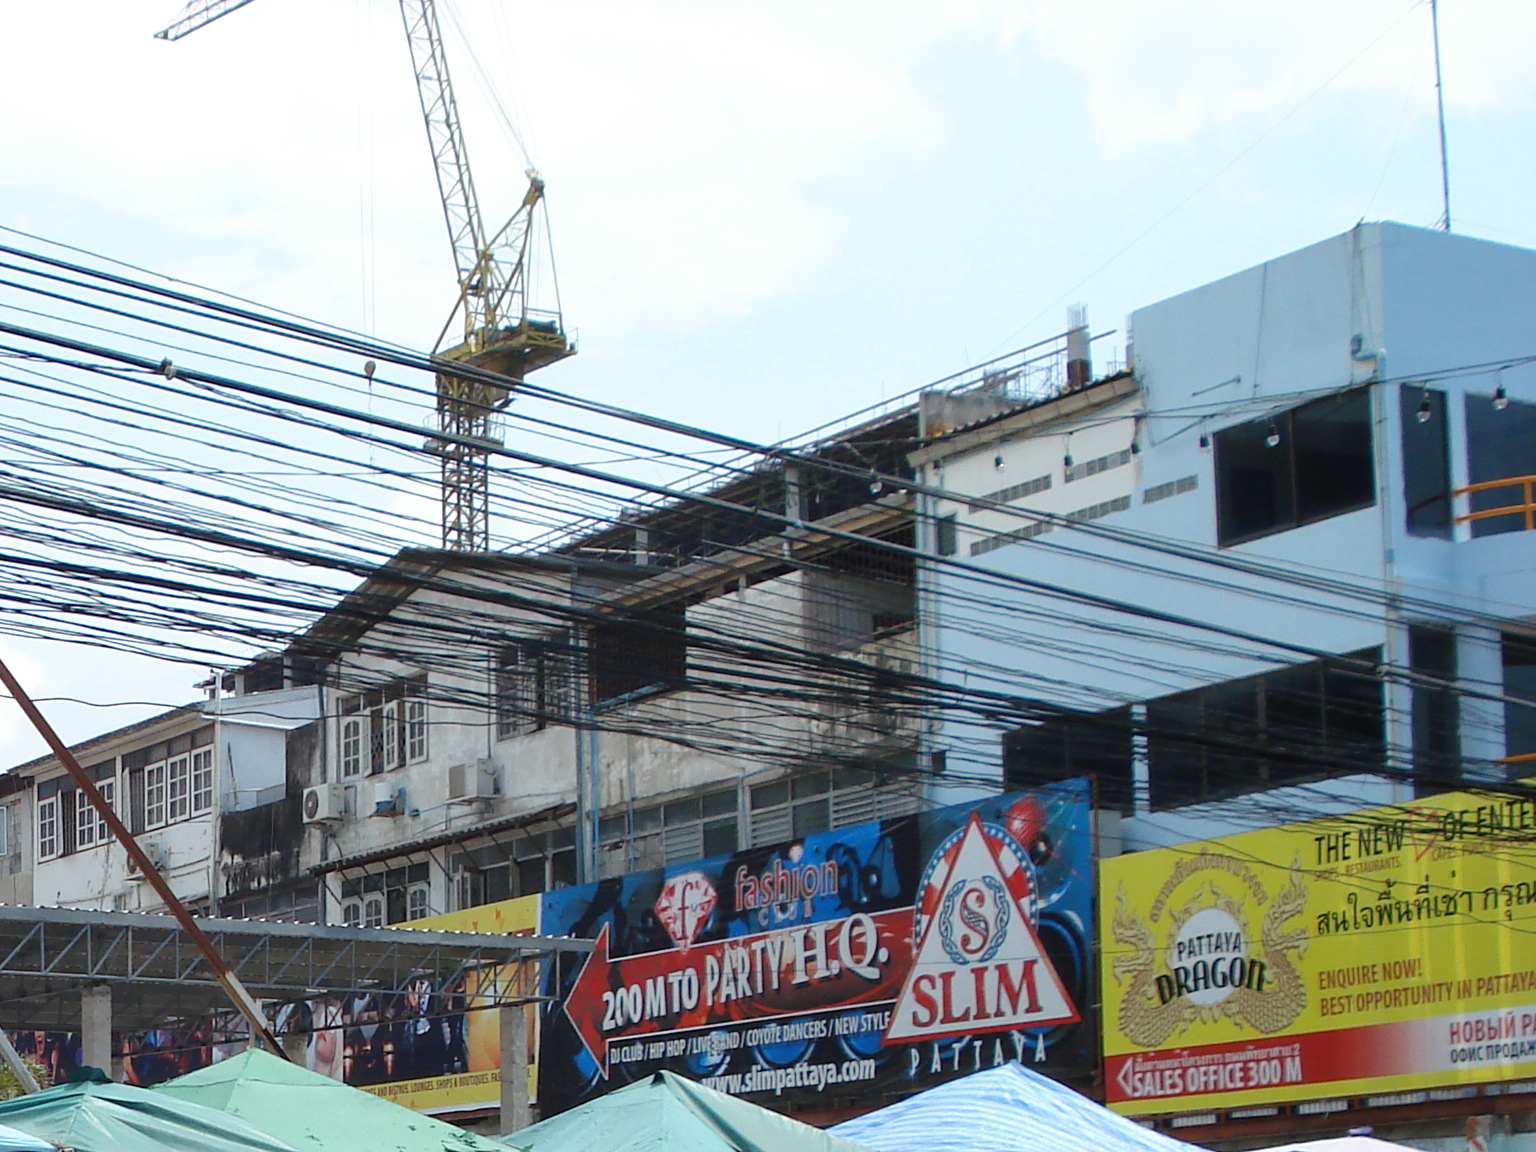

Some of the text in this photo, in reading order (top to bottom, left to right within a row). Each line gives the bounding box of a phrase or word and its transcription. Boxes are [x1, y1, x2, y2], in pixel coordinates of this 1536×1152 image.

[1315, 831, 1351, 865] THE
[1359, 821, 1406, 858] NEW
[735, 858, 838, 911] fashion
[668, 967, 699, 1013] TO
[705, 935, 783, 1006] PARTY
[791, 912, 889, 985] H.Q.
[1177, 932, 1241, 961] PATTAYA
[912, 959, 1044, 1027] SLIM
[1155, 957, 1267, 1005] DRAGON
[1318, 958, 1422, 990] ENQUIRE NOW!
[1321, 970, 1536, 1017] BEST OPPORTUNITY IN PATTAYA
[610, 1047, 621, 1064] DJ
[622, 1042, 643, 1062] CLUB
[650, 1042, 663, 1060] HIP
[666, 1039, 686, 1057] HOP
[693, 1036, 711, 1055] LIVE
[713, 1032, 739, 1051] BAND
[747, 1026, 781, 1048] COYOTE
[783, 1020, 826, 1043] DANCERS
[835, 1016, 860, 1035] NEW
[1450, 1011, 1516, 1045] НОВЫЙ
[910, 1031, 1046, 1076] PATTAYA
[1451, 1045, 1483, 1063] ОФИС
[702, 1059, 875, 1096] www.slimpattaya.com
[1133, 1069, 1183, 1097] SALES
[1186, 1062, 1244, 1092] OFFICE
[1247, 1059, 1281, 1086] 300
[1286, 1056, 1302, 1082] M
